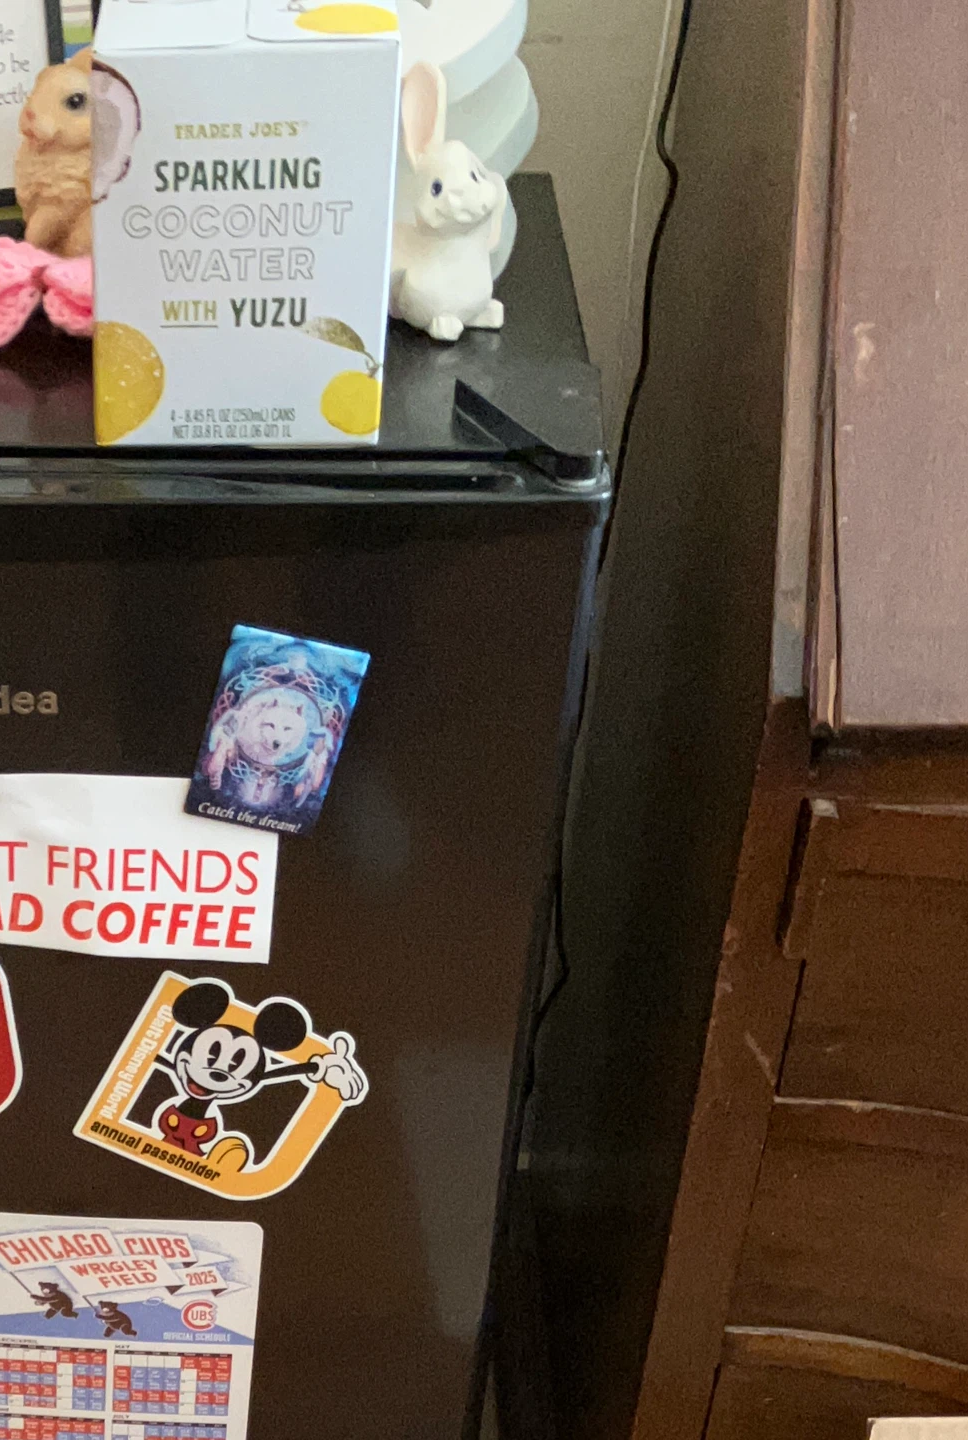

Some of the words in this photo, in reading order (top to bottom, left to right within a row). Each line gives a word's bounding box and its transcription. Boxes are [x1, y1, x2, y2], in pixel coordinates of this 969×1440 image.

[10, 52, 31, 74] be
[174, 123, 242, 139] TRADER
[249, 122, 299, 138] JOE'S
[154, 158, 321, 192] SPARKLING
[122, 200, 353, 239] COCONUT
[159, 247, 316, 282] WATER
[162, 300, 217, 321] WITH
[230, 298, 307, 327] YUZU
[271, 408, 296, 421] CANS
[172, 425, 189, 438] NET
[198, 802, 234, 819] Catch
[237, 809, 257, 824] the
[259, 814, 303, 833] dream!
[46, 845, 260, 896] FRIENDS
[62, 900, 257, 950] COFFEE
[146, 1005, 173, 1039] Walt
[118, 1037, 158, 1081] Disney
[99, 1080, 133, 1120] World
[90, 1121, 142, 1149] annual
[141, 1143, 220, 1182] passholder
[124, 1237, 191, 1259] CUBS
[70, 1259, 157, 1277] WRIGLEY
[98, 1272, 157, 1288] FIELD
[185, 1270, 218, 1286] 2025
[163, 1332, 193, 1341] OFFICIAL
[195, 1332, 231, 1342] SCHEDULE
